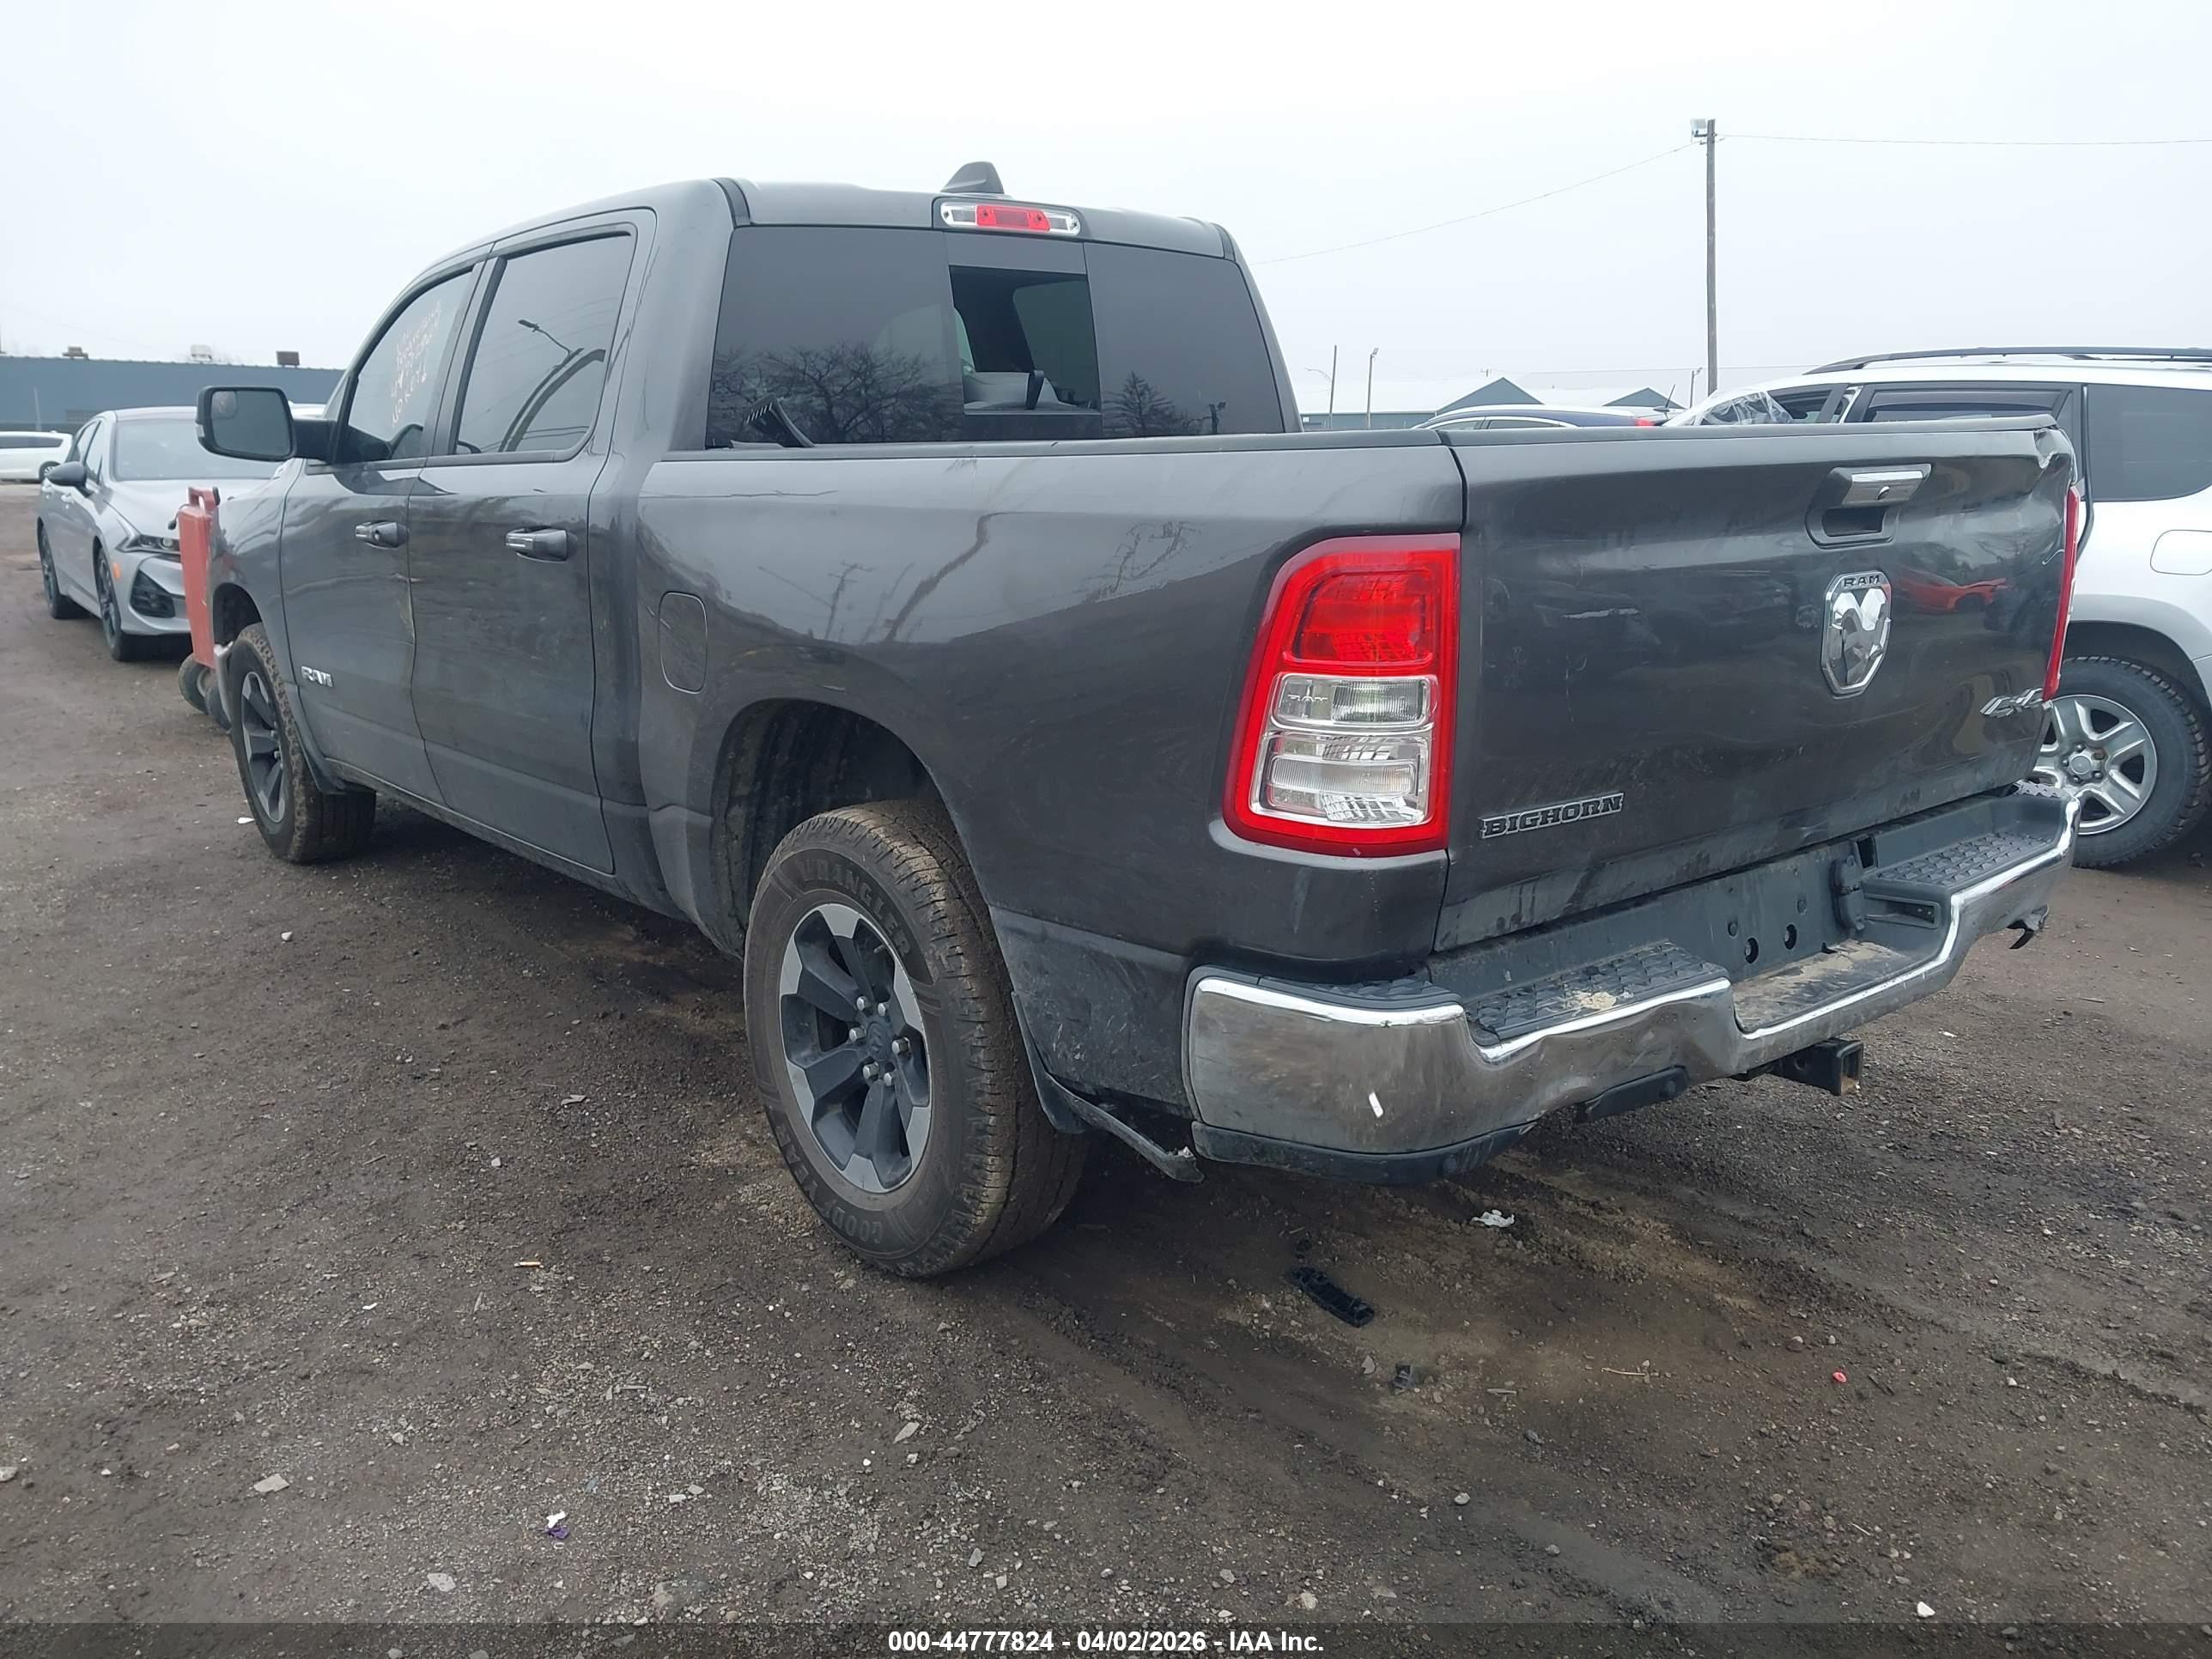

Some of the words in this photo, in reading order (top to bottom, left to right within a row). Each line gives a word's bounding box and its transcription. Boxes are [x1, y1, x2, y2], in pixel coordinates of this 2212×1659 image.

[1844, 574, 1880, 587] RAM
[301, 665, 333, 688] RAM
[1479, 793, 1625, 839] BIGHORN
[799, 858, 911, 957] WRANGLER
